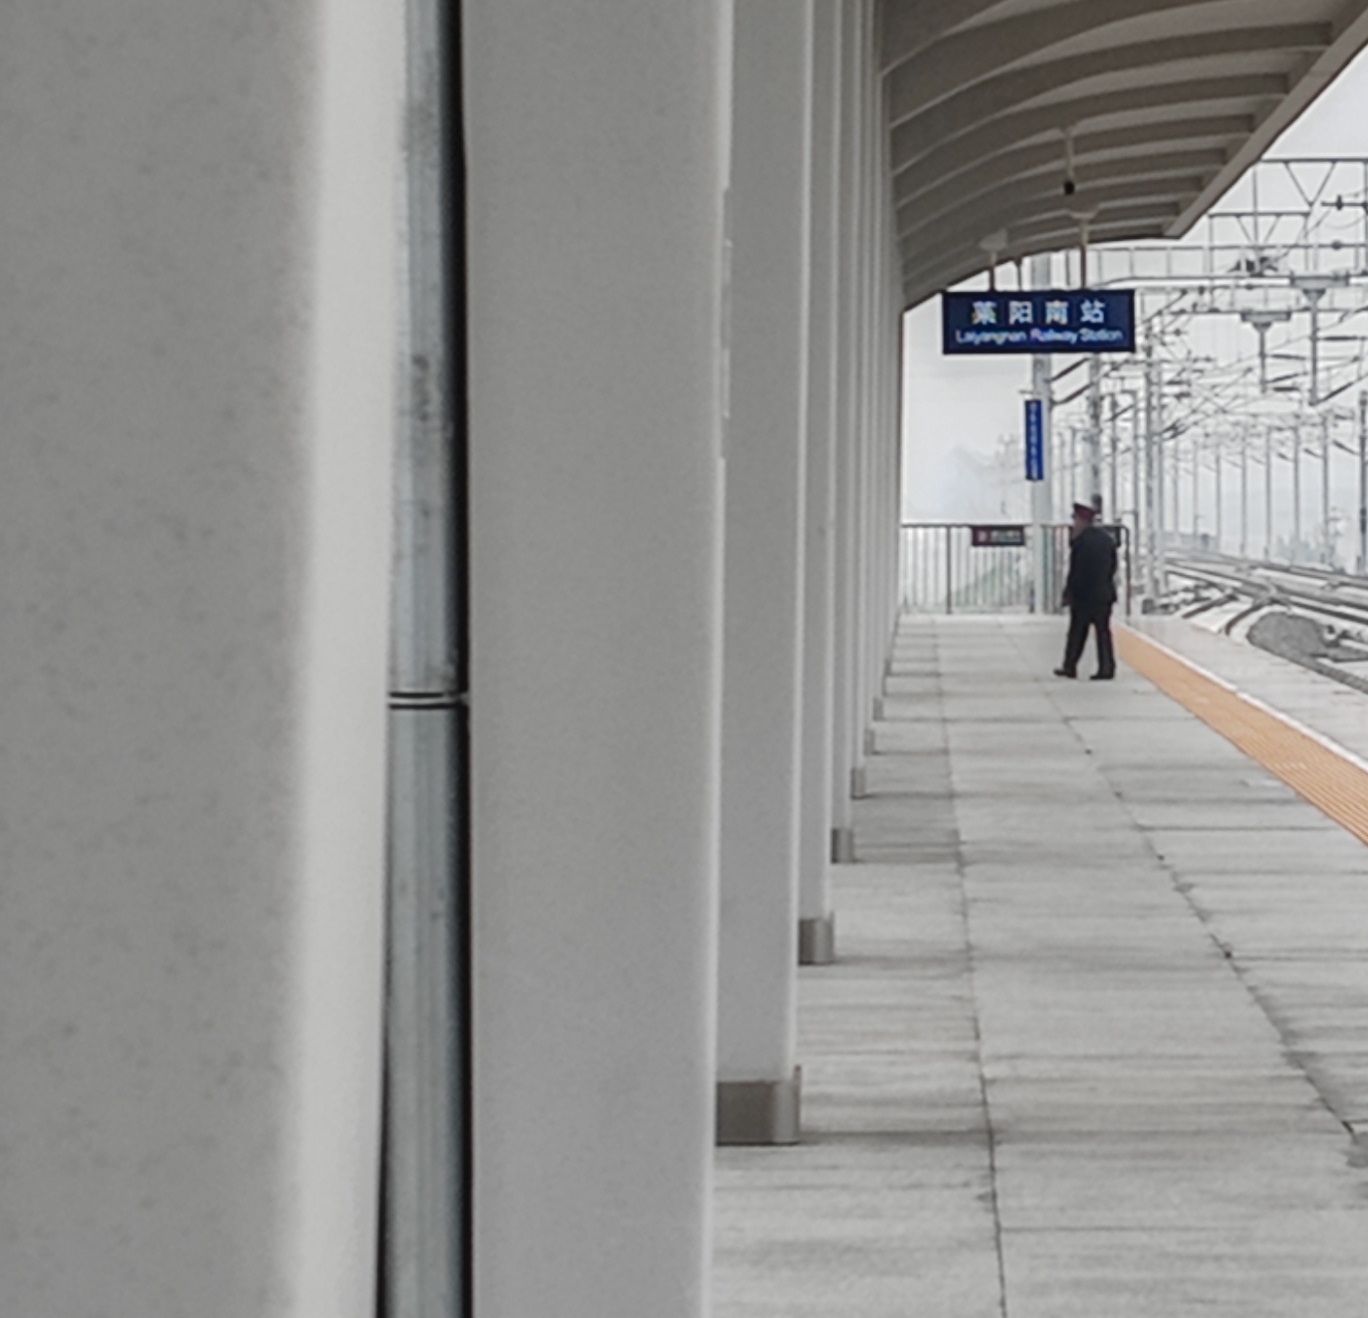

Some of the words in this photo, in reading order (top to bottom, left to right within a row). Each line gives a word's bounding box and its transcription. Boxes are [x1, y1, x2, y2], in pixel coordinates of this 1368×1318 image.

[972, 299, 1106, 325] 莱阳南站
[1030, 328, 1078, 344] Railway
[1079, 327, 1123, 343] Station
